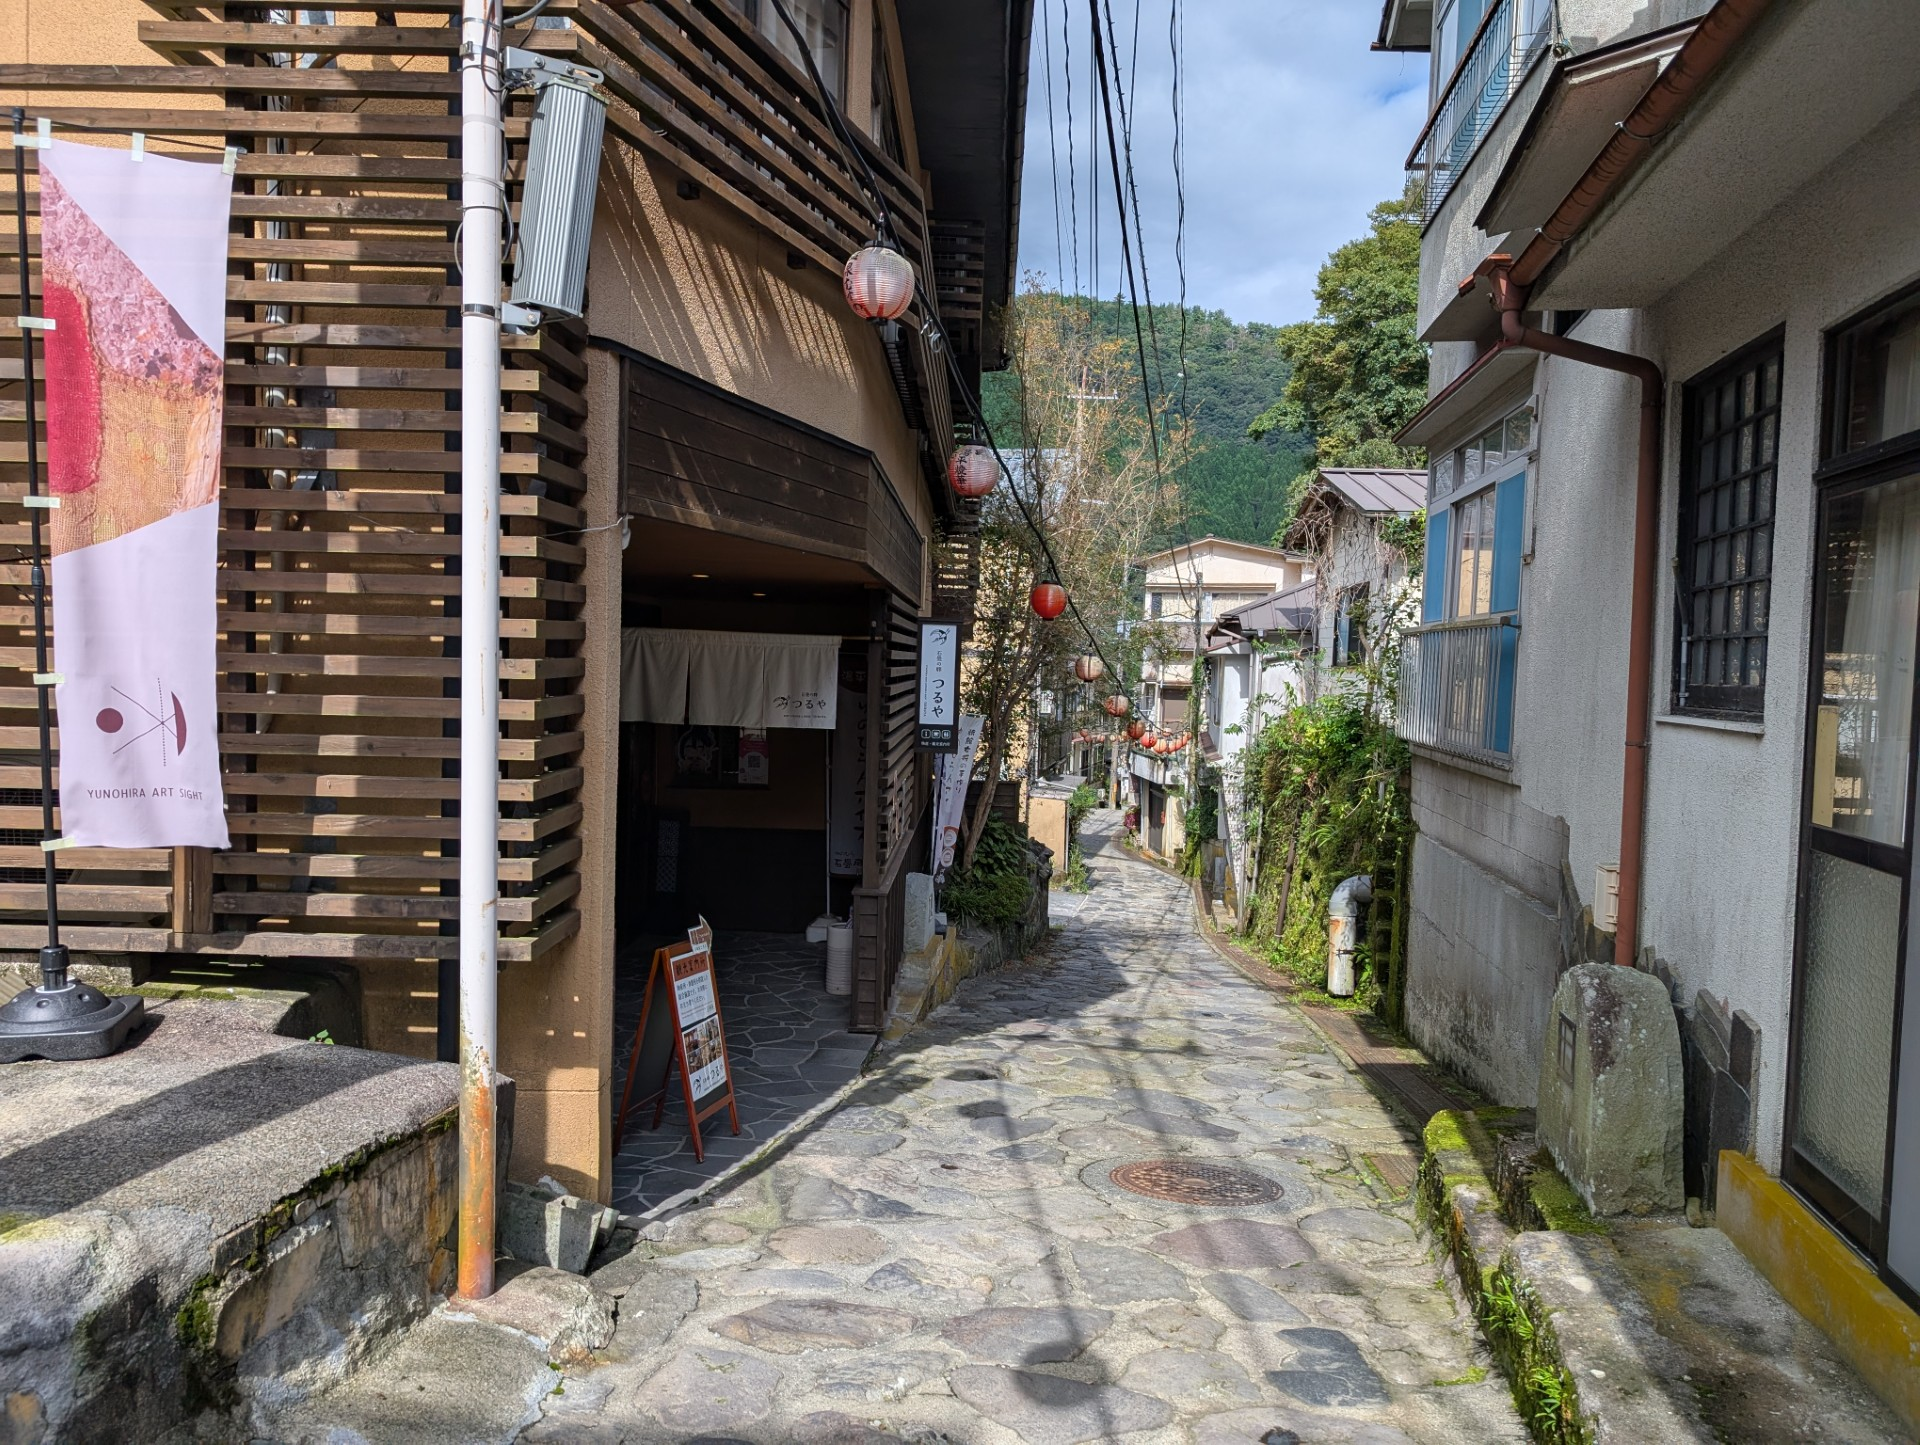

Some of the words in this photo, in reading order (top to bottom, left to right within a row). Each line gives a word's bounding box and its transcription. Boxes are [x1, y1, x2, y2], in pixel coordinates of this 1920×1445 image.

[792, 699, 827, 710] つるや
[931, 679, 945, 719] つるや
[87, 788, 147, 800] YUNOHIRA
[152, 787, 174, 798] ART
[179, 789, 203, 801] SIGHT
